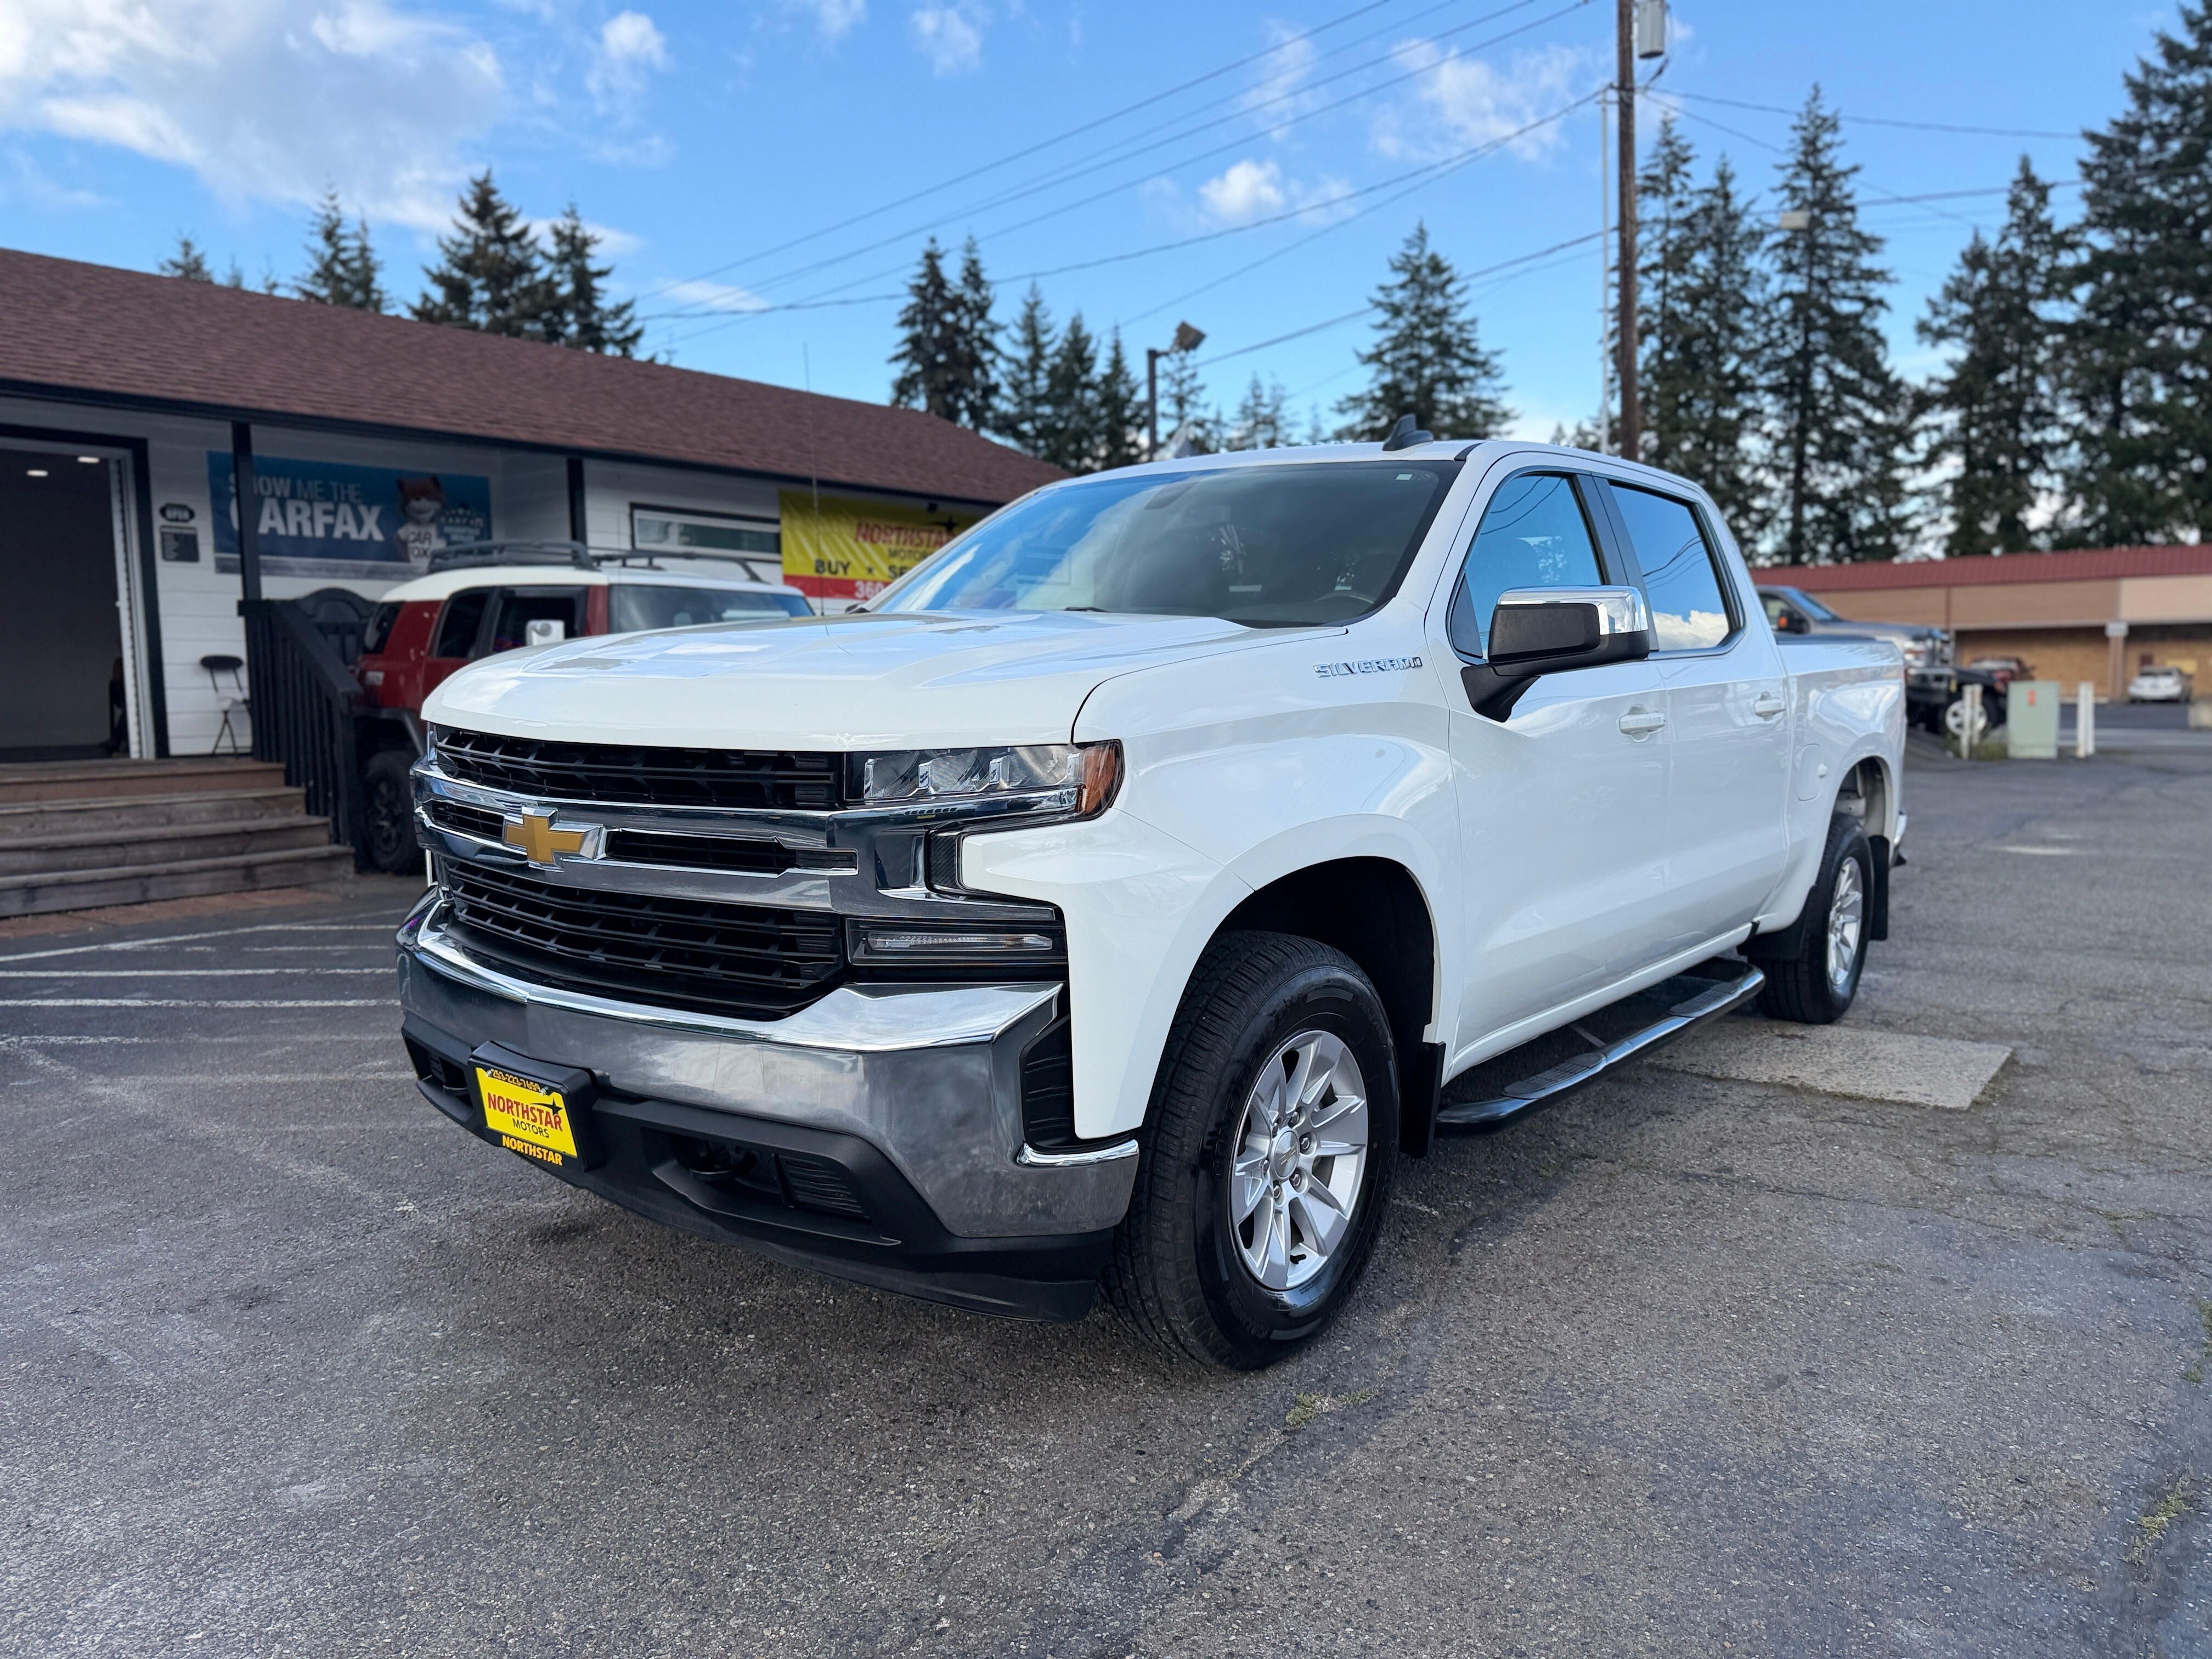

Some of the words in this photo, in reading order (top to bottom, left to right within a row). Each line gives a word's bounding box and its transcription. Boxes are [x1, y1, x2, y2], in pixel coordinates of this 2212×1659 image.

[297, 479, 325, 501] ME
[330, 481, 362, 504] THE
[814, 559, 851, 575] BUY
[1313, 657, 1423, 678] SILVERADO
[488, 1092, 563, 1132] NORTHSTAR
[512, 1118, 550, 1139] MOTORS
[502, 1135, 563, 1166] NORTHSTAR
